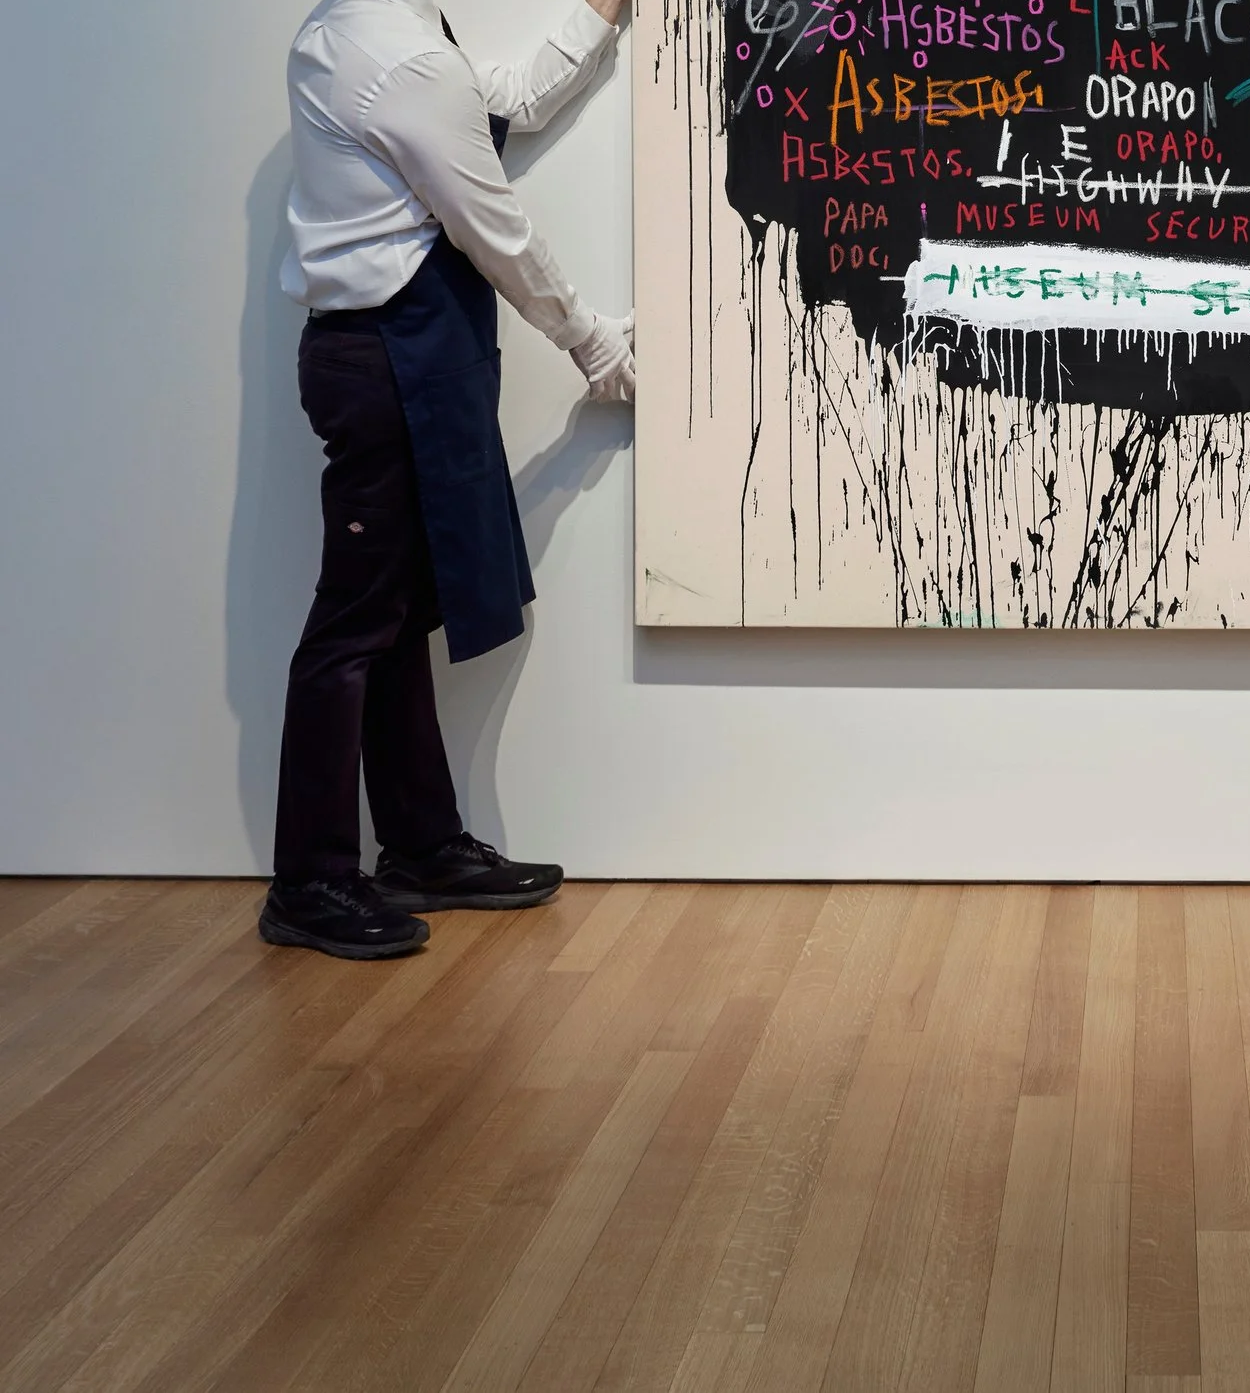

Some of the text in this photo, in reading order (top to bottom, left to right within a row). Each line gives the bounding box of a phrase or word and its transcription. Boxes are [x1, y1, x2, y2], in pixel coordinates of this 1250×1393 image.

[783, 86, 810, 122] X
[1085, 73, 1197, 122] ORAPO
[823, 195, 890, 239] PAPA
[955, 202, 1102, 234] MUSEUM
